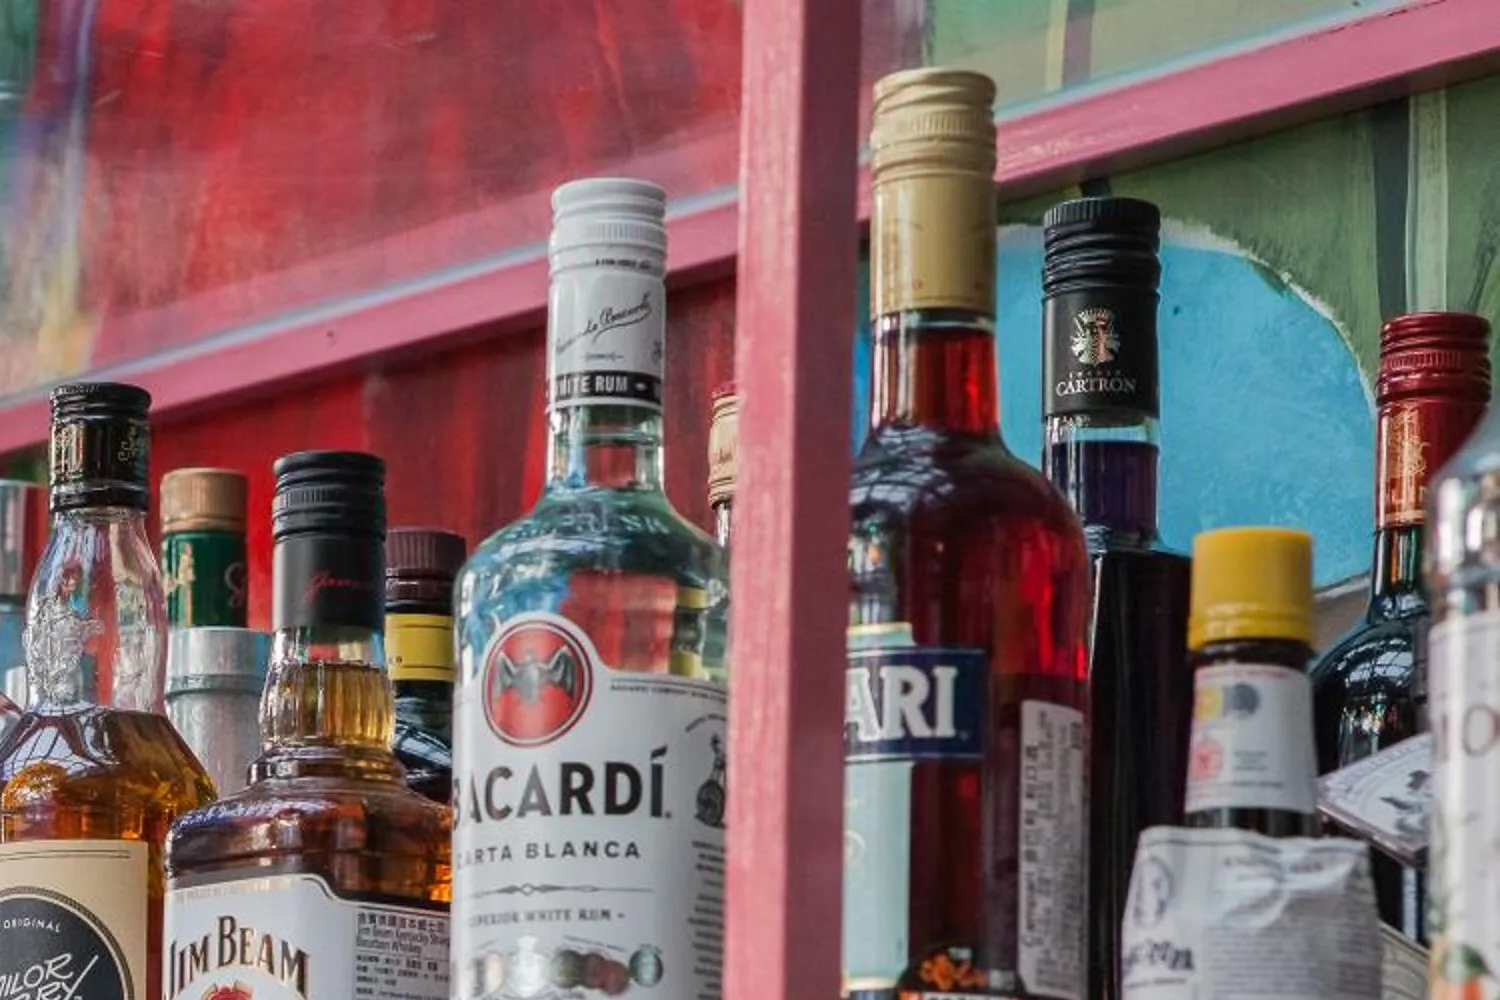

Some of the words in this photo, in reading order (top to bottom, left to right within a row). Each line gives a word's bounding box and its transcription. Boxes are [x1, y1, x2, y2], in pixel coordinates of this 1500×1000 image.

[595, 375, 628, 392] RUM
[1055, 377, 1138, 397] CARTRON
[845, 665, 959, 742] ARI
[525, 840, 641, 860] BLANCA
[578, 908, 611, 922] RUM
[3, 916, 61, 934] ORIGINAL
